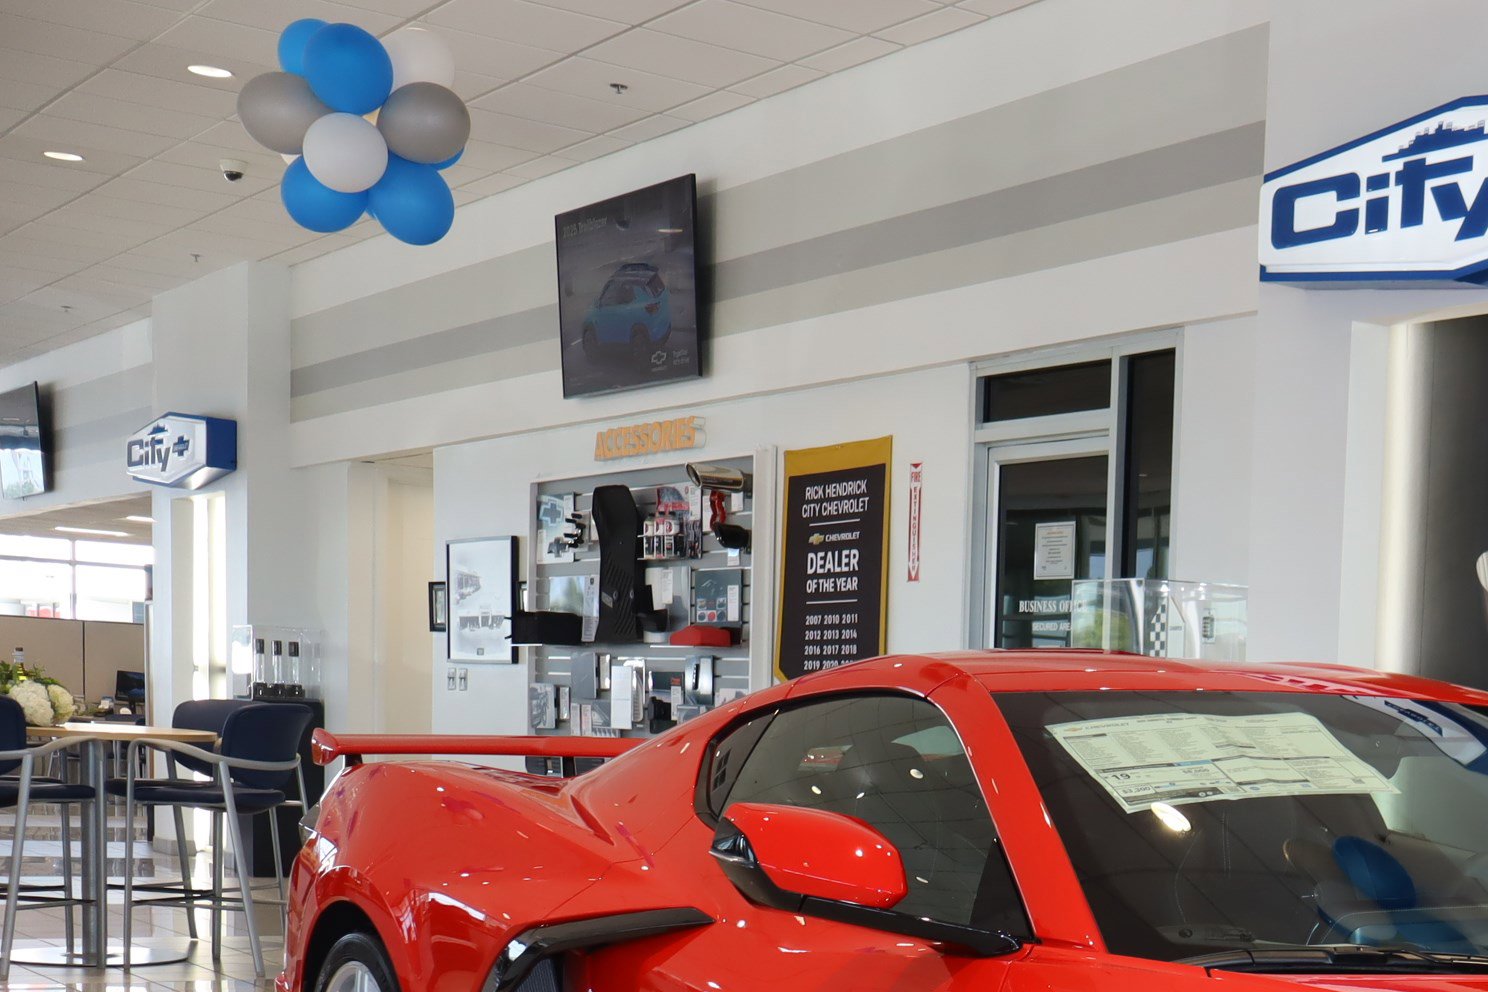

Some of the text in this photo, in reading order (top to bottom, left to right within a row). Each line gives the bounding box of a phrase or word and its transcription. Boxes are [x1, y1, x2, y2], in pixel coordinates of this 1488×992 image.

[594, 416, 706, 461] ACCESSORIES
[127, 436, 171, 472] City
[911, 471, 921, 482] FIRE
[805, 479, 867, 500] RICK HENDRICK
[801, 497, 869, 518] CITY CHEVROLET
[825, 531, 860, 542] CHEVROLET
[807, 549, 859, 575] DEALER
[806, 576, 858, 593] OF THE YEAR
[1019, 600, 1057, 612] BUSINESS
[805, 613, 858, 625] 2007 2010 2011
[1032, 623, 1058, 631] SECURED
[805, 629, 857, 640] 2012 2013 2014
[804, 644, 857, 655] 2016 2017 2018
[803, 660, 820, 670] 2019
[1111, 772, 1131, 780] 19
